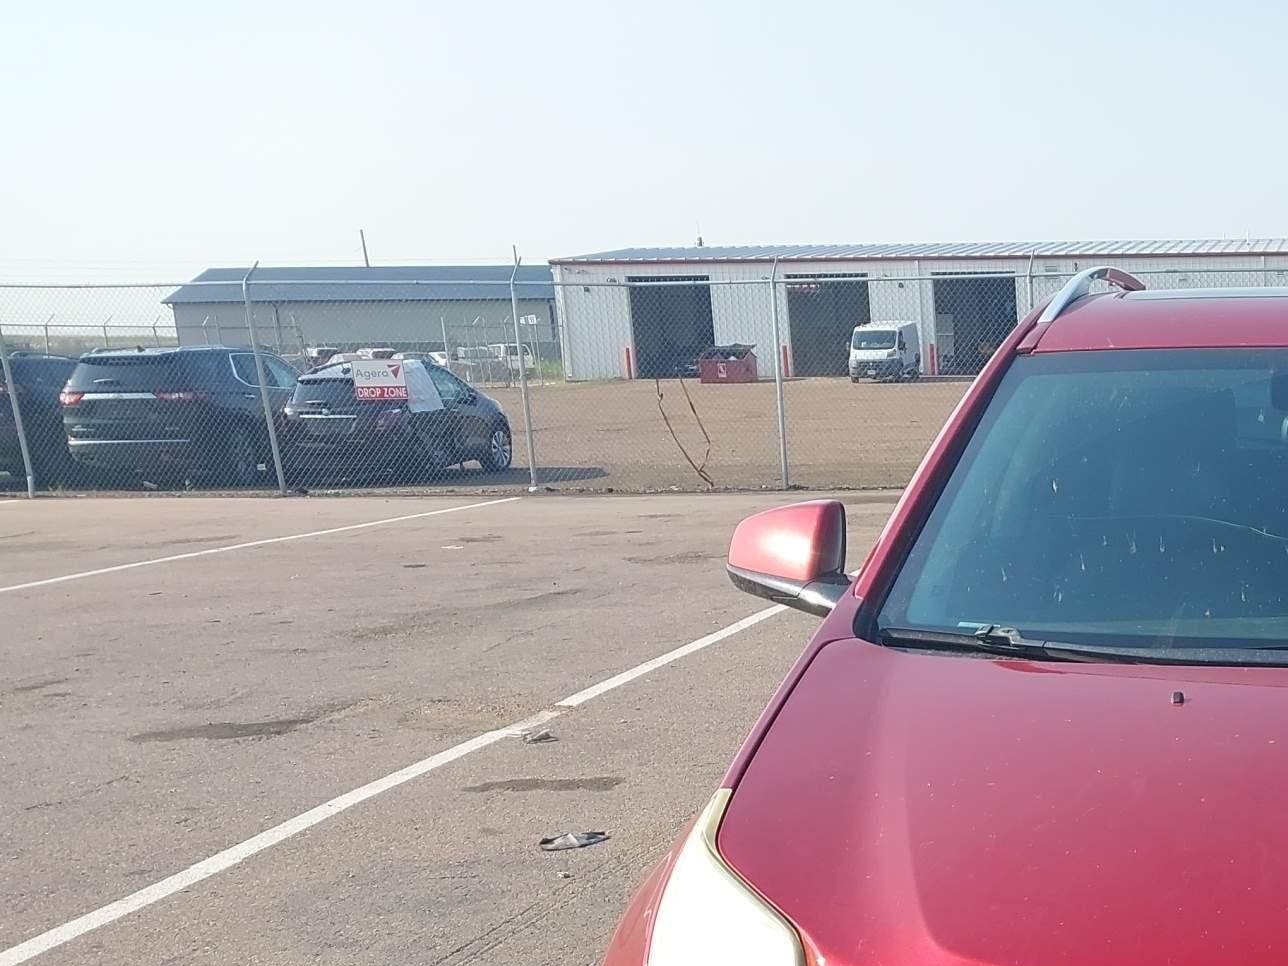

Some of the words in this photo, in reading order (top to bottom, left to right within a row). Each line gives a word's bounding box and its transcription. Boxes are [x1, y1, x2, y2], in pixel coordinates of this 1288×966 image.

[355, 369, 389, 380] Agero
[357, 387, 381, 398] DROP
[383, 387, 408, 398] ZONE
